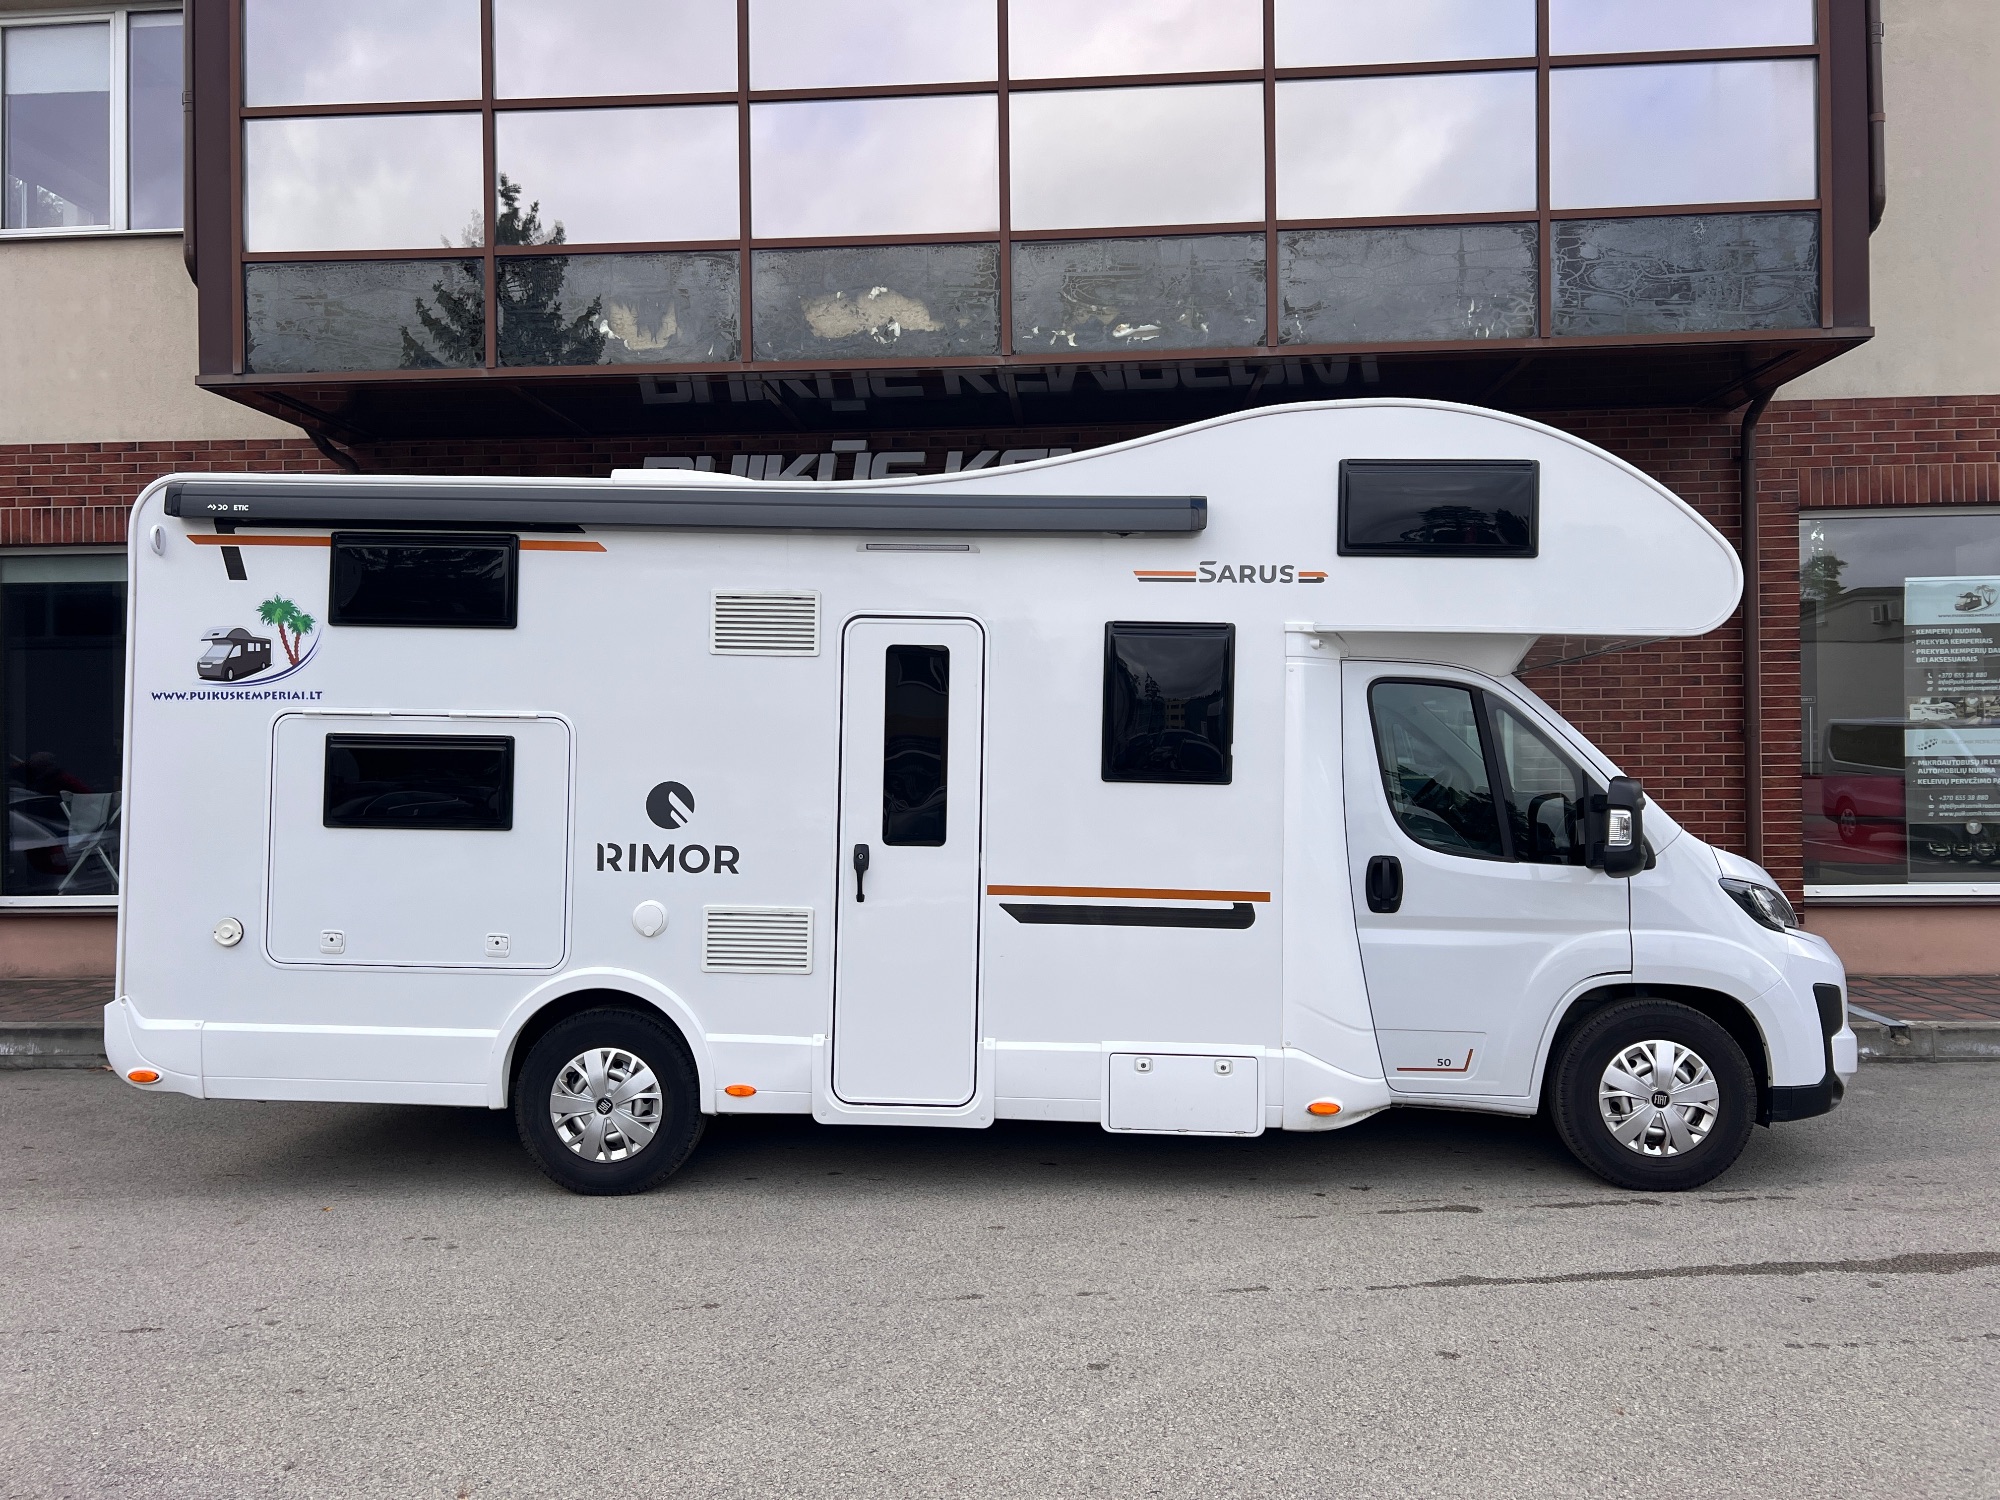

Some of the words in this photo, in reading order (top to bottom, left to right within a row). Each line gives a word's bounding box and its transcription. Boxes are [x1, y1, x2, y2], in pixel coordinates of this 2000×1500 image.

[1198, 560, 1294, 584] SARUS
[151, 690, 323, 701] WWW.PUIKUSKEMPERIAI.LT
[597, 843, 740, 874] RIMOR
[1437, 1058, 1451, 1067] 50
[1654, 1094, 1667, 1105] FIAT
